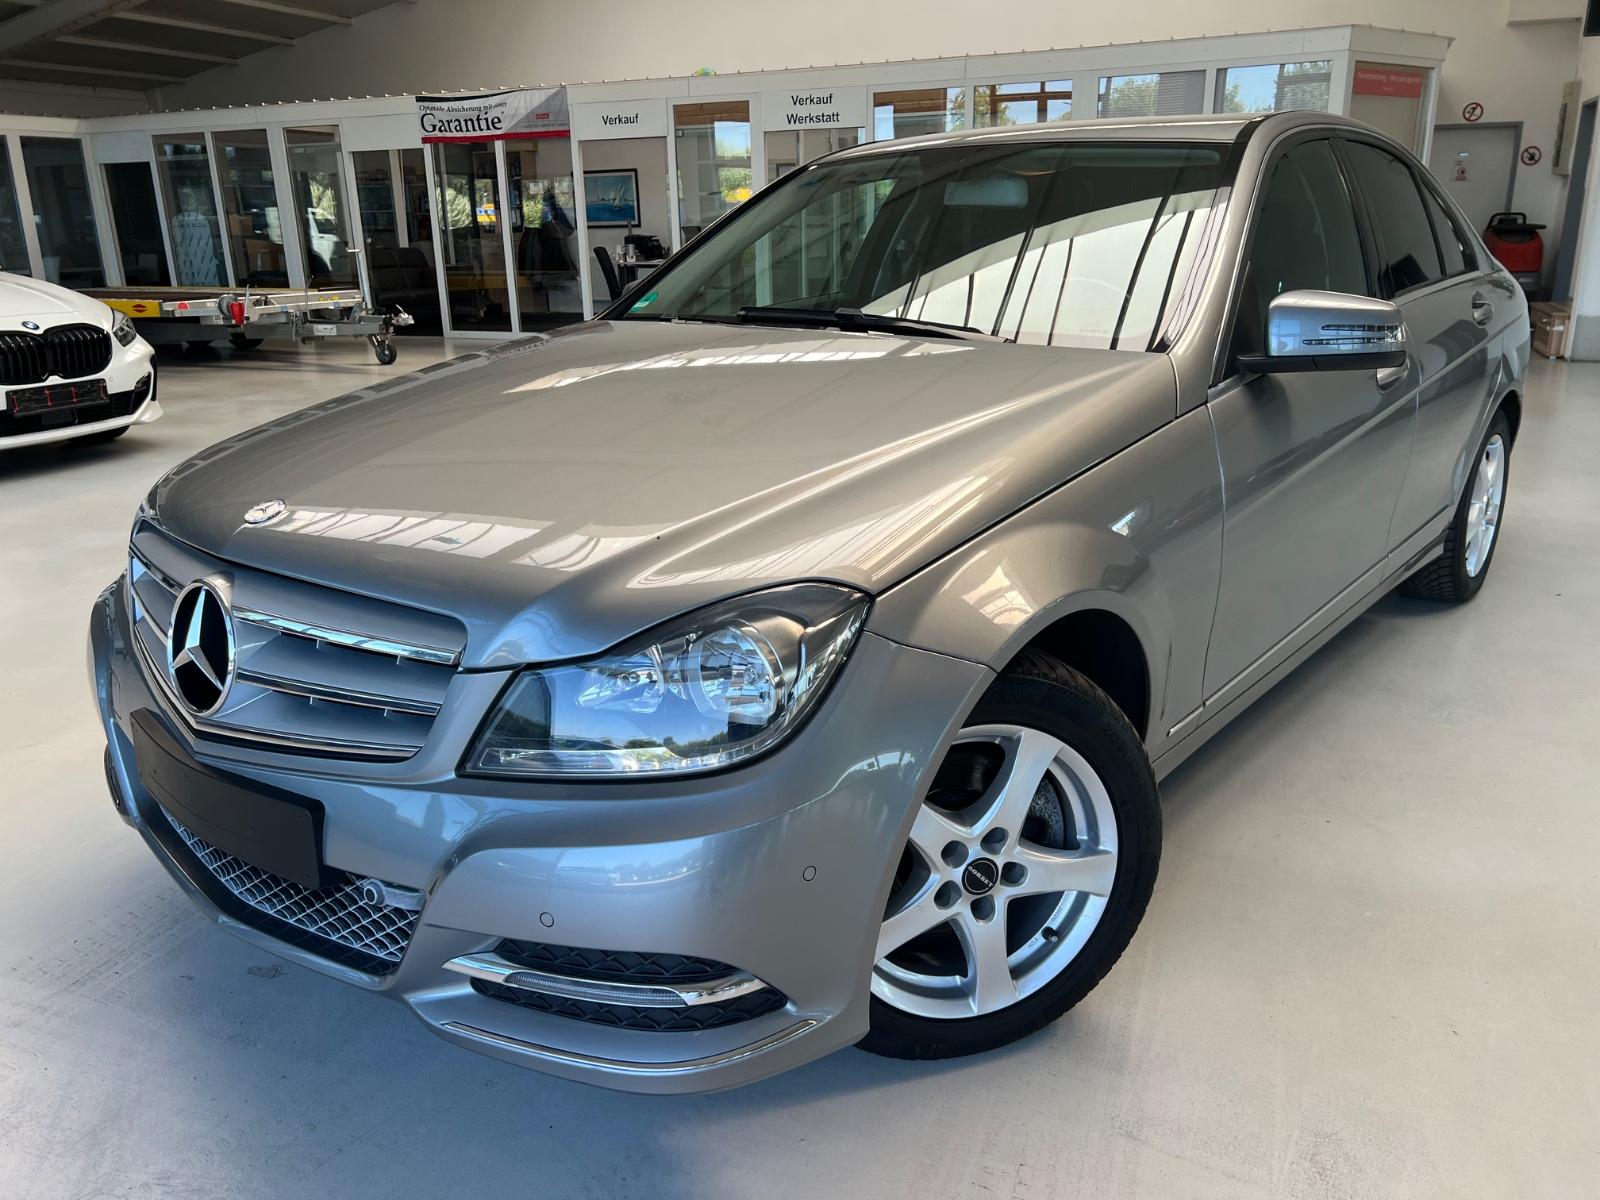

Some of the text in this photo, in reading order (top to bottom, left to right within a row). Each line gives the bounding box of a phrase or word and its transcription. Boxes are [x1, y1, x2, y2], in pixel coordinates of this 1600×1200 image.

[791, 94, 834, 106] Verkauf
[446, 105, 482, 113] Absicherung
[601, 113, 640, 126] Verkauf
[786, 112, 840, 125] Werkstatt
